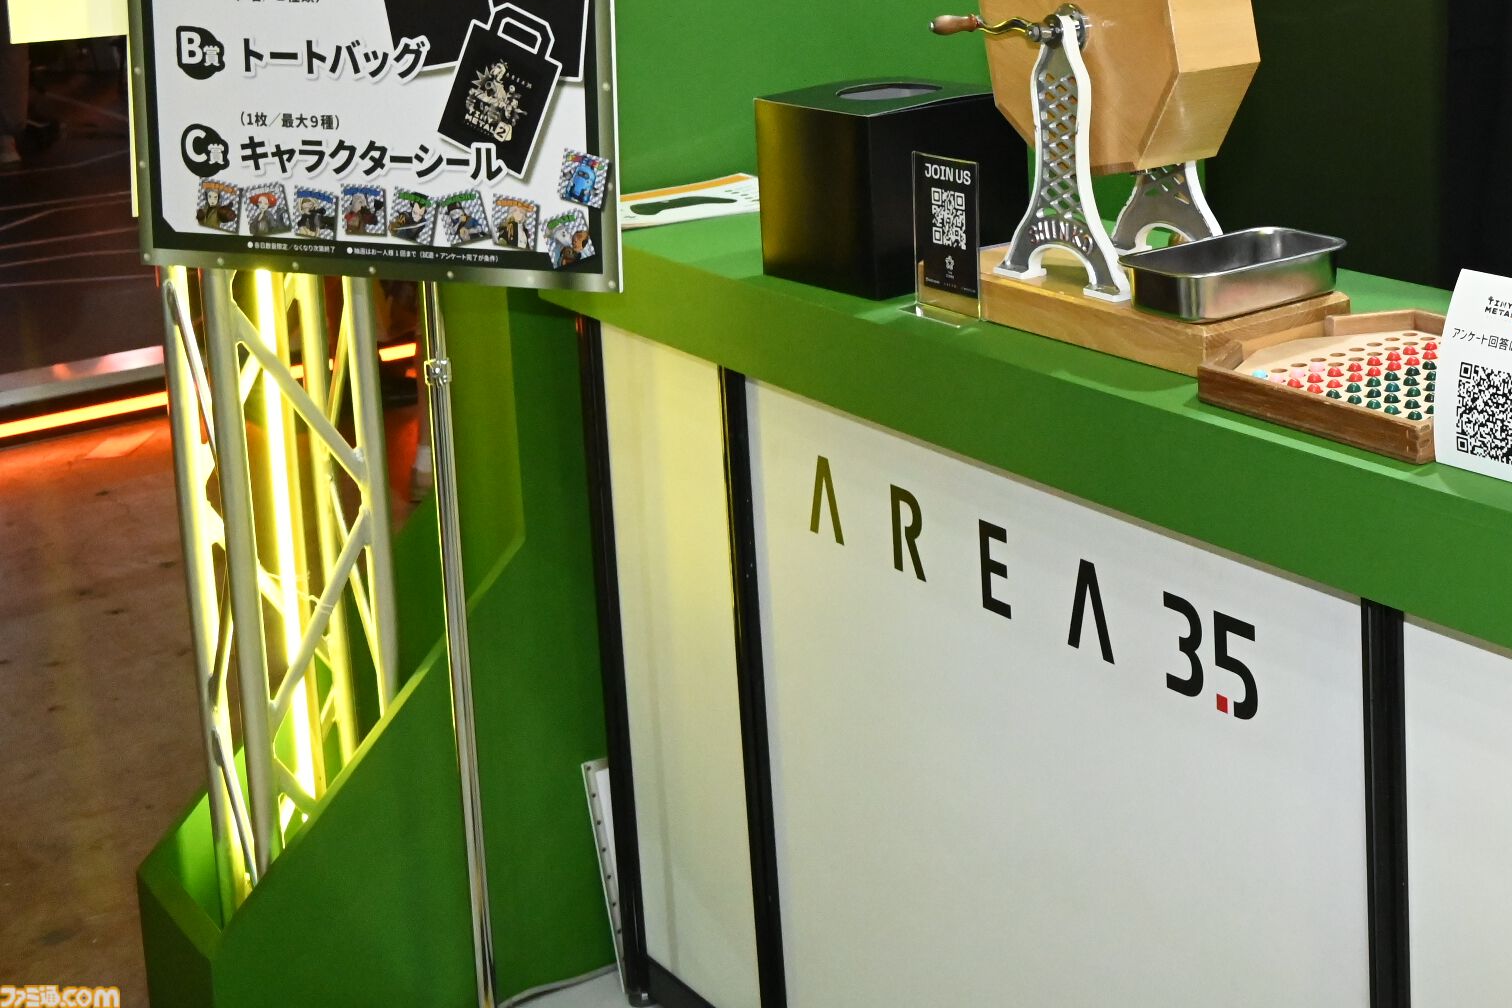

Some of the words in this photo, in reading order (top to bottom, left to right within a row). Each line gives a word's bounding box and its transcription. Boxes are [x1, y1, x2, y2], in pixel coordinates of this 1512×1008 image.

[243, 37, 425, 79] トートバッグ
[240, 135, 505, 183] キャラクターシール
[924, 163, 954, 182] JOIN
[955, 170, 971, 185] US
[809, 455, 1115, 665] AREA
